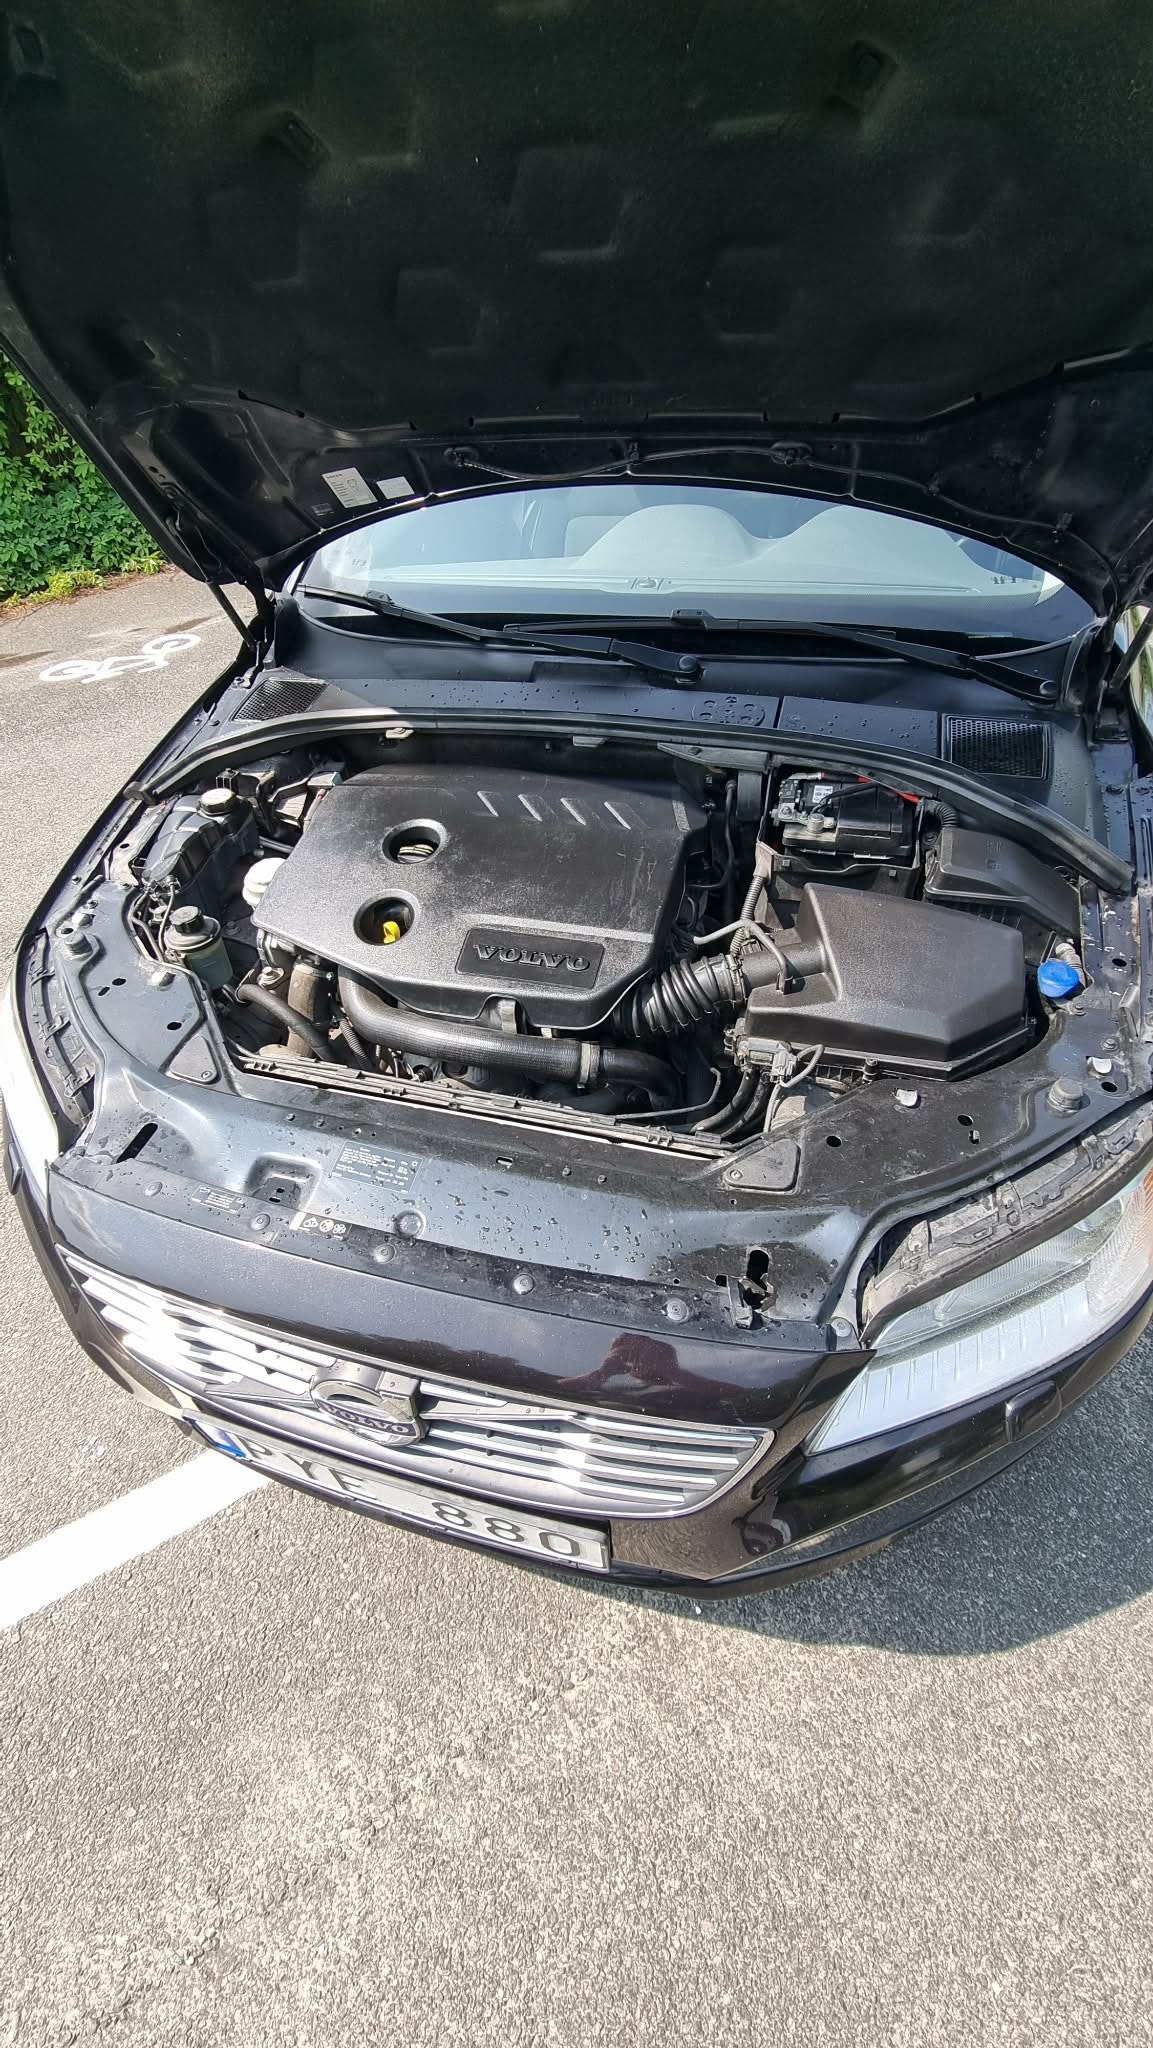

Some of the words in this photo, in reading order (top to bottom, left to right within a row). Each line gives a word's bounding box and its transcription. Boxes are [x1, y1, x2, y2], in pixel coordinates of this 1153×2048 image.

[473, 944, 591, 972] VOLVO
[322, 1402, 409, 1434] VOLVO
[431, 1501, 581, 1557] 880
